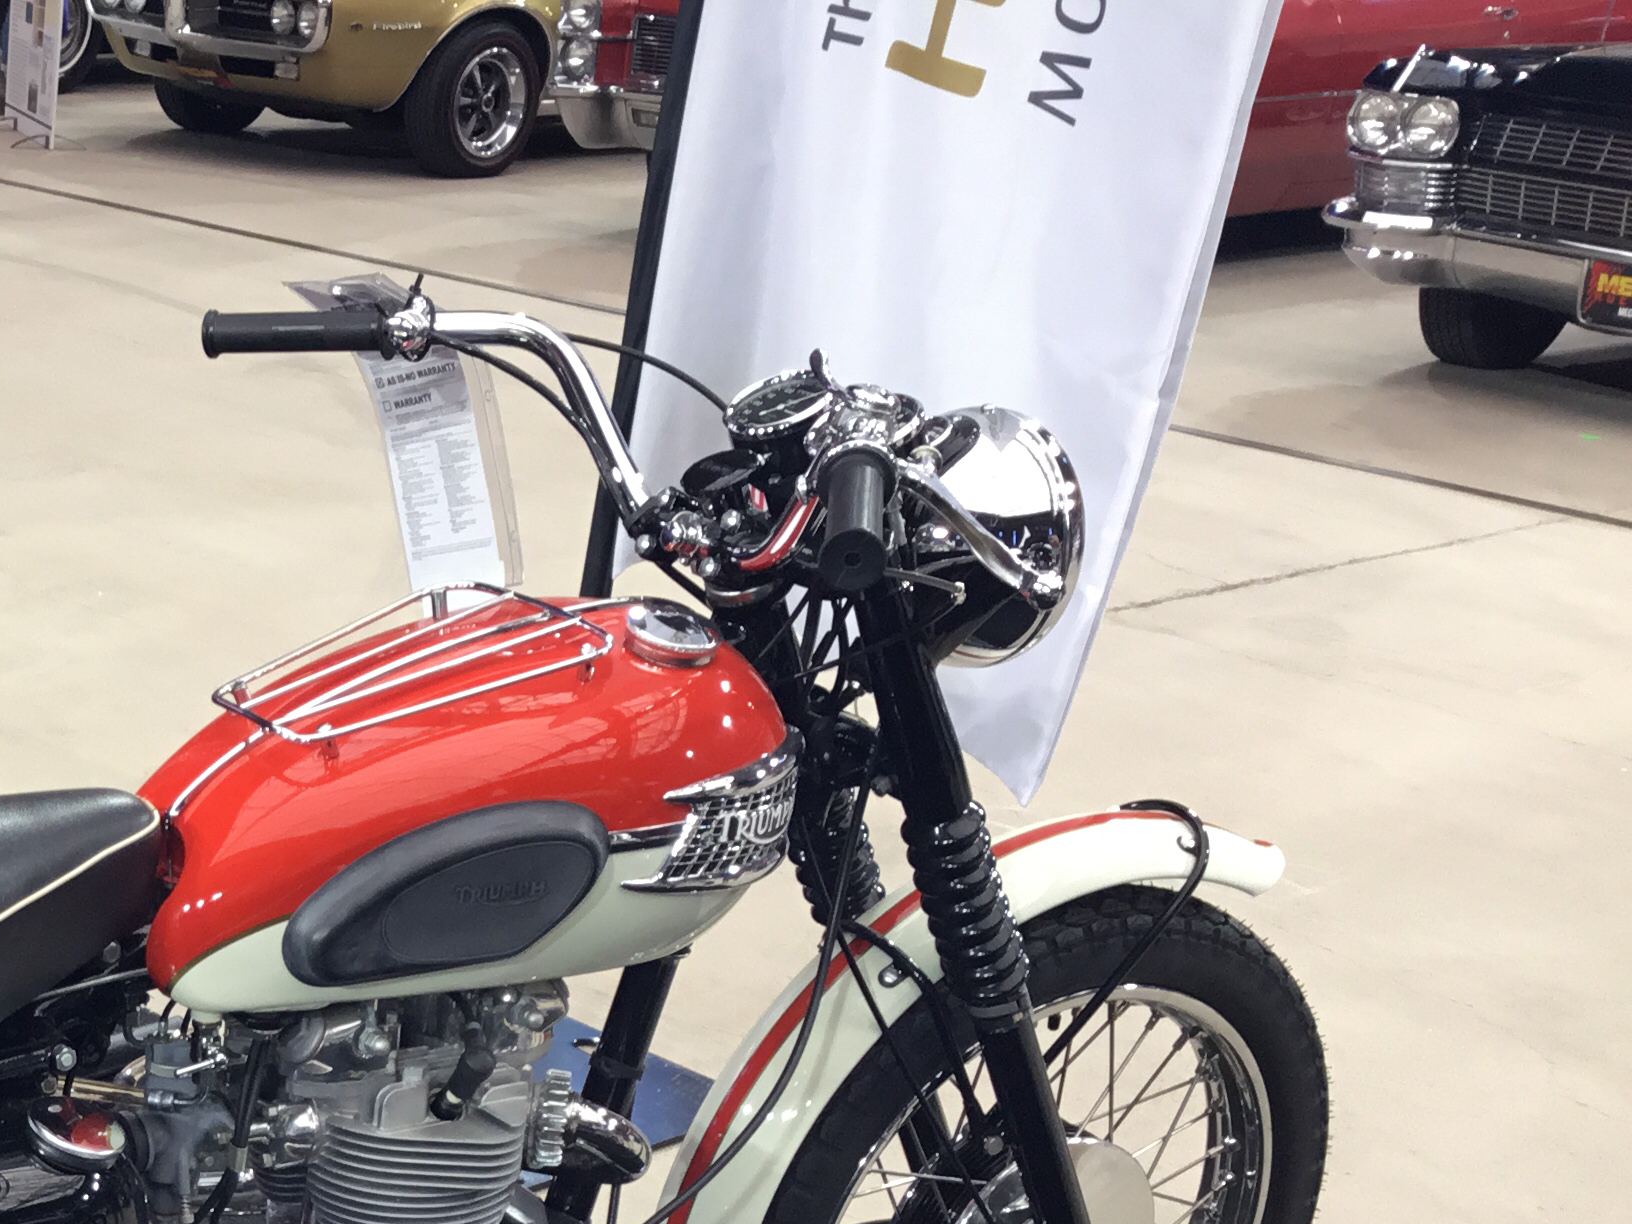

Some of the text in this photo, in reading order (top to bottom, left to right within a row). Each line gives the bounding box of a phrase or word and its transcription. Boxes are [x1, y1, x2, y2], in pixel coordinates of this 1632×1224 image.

[416, 361, 456, 379] WARRANTY
[393, 392, 432, 410] WARRANTY
[715, 796, 794, 844] TRIUMP
